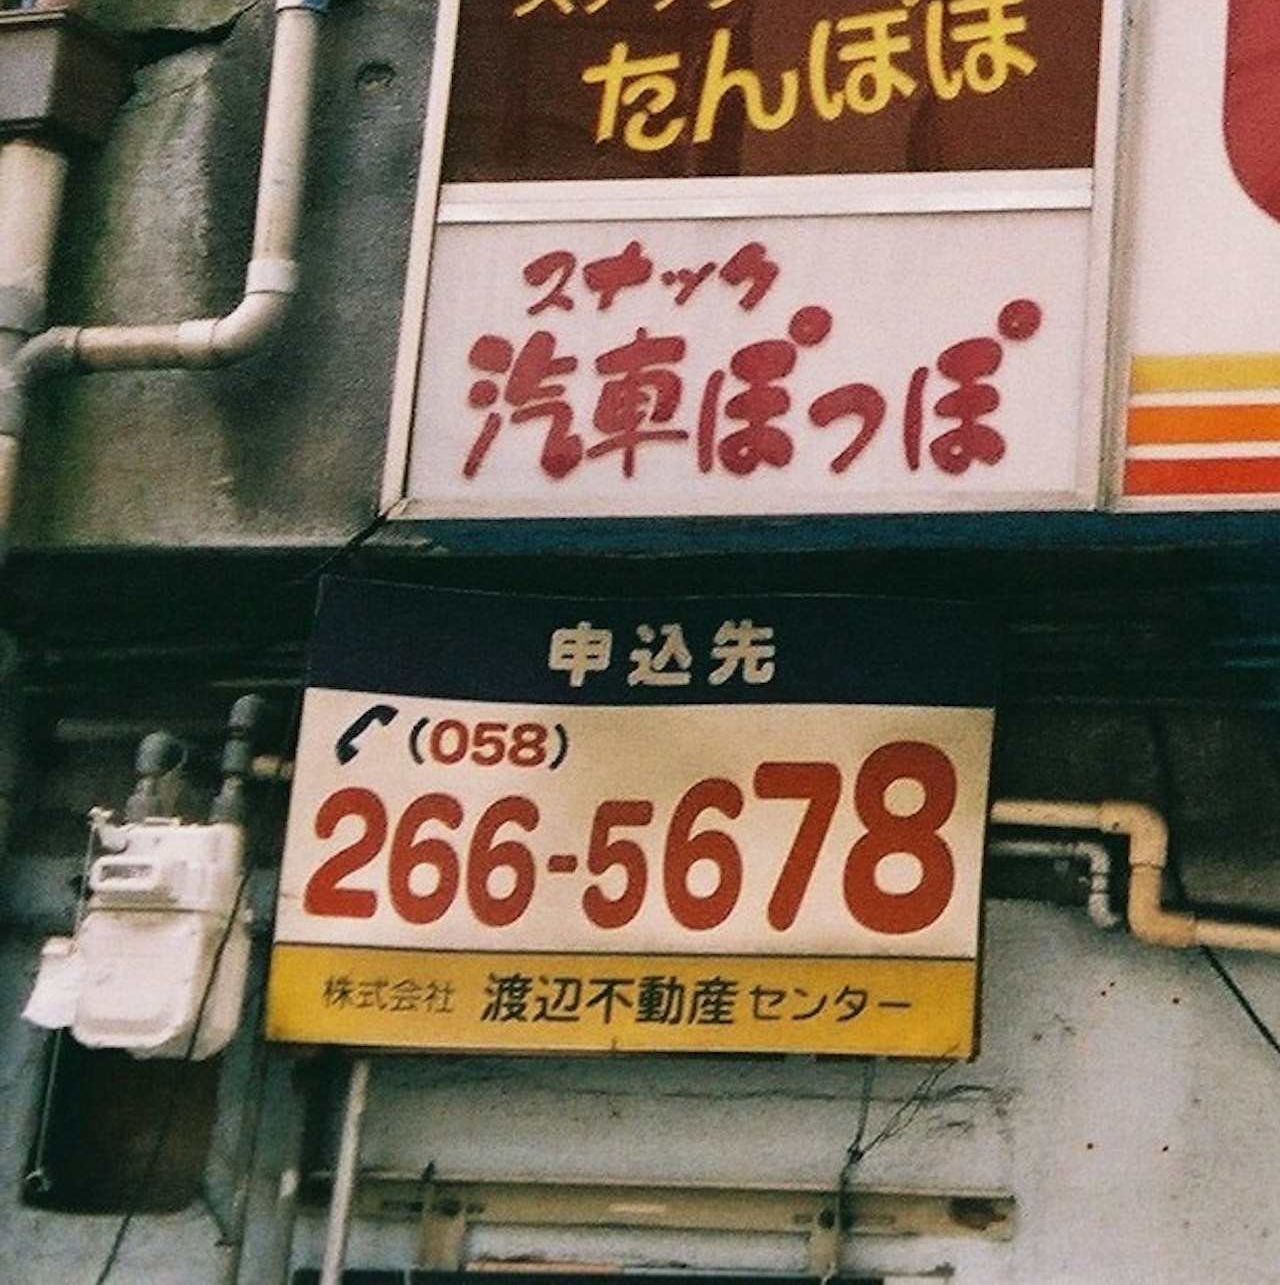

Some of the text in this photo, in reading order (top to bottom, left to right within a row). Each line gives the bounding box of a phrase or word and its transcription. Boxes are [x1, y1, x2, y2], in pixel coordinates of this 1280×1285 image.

[522, 240, 781, 314] スナック
[462, 297, 1043, 479] 汽車ぽっぽ
[548, 618, 778, 688] 申込先
[408, 716, 570, 771] (058)
[302, 739, 958, 936] 266-5678
[323, 972, 912, 1026] 株式会社 渡辺不動産センター
